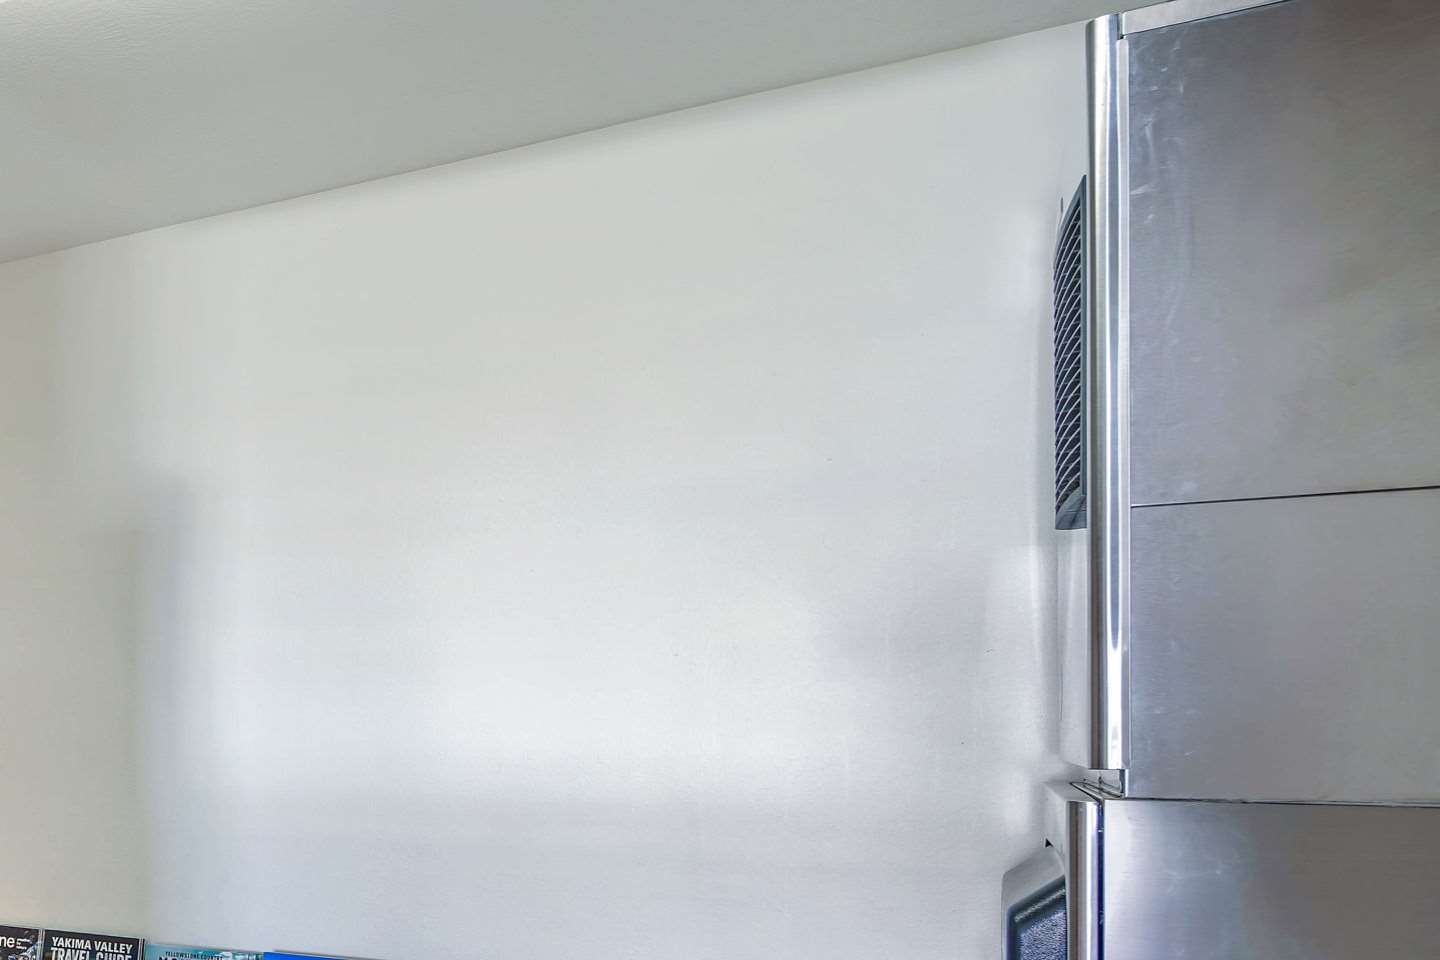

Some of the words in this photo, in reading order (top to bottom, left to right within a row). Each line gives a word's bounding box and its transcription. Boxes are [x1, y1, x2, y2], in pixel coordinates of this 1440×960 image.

[51, 936, 92, 950] YAKIMA
[94, 940, 133, 954] VALLEY
[165, 951, 199, 960] YELLOWSTONE
[200, 953, 223, 960] COUNTRY
